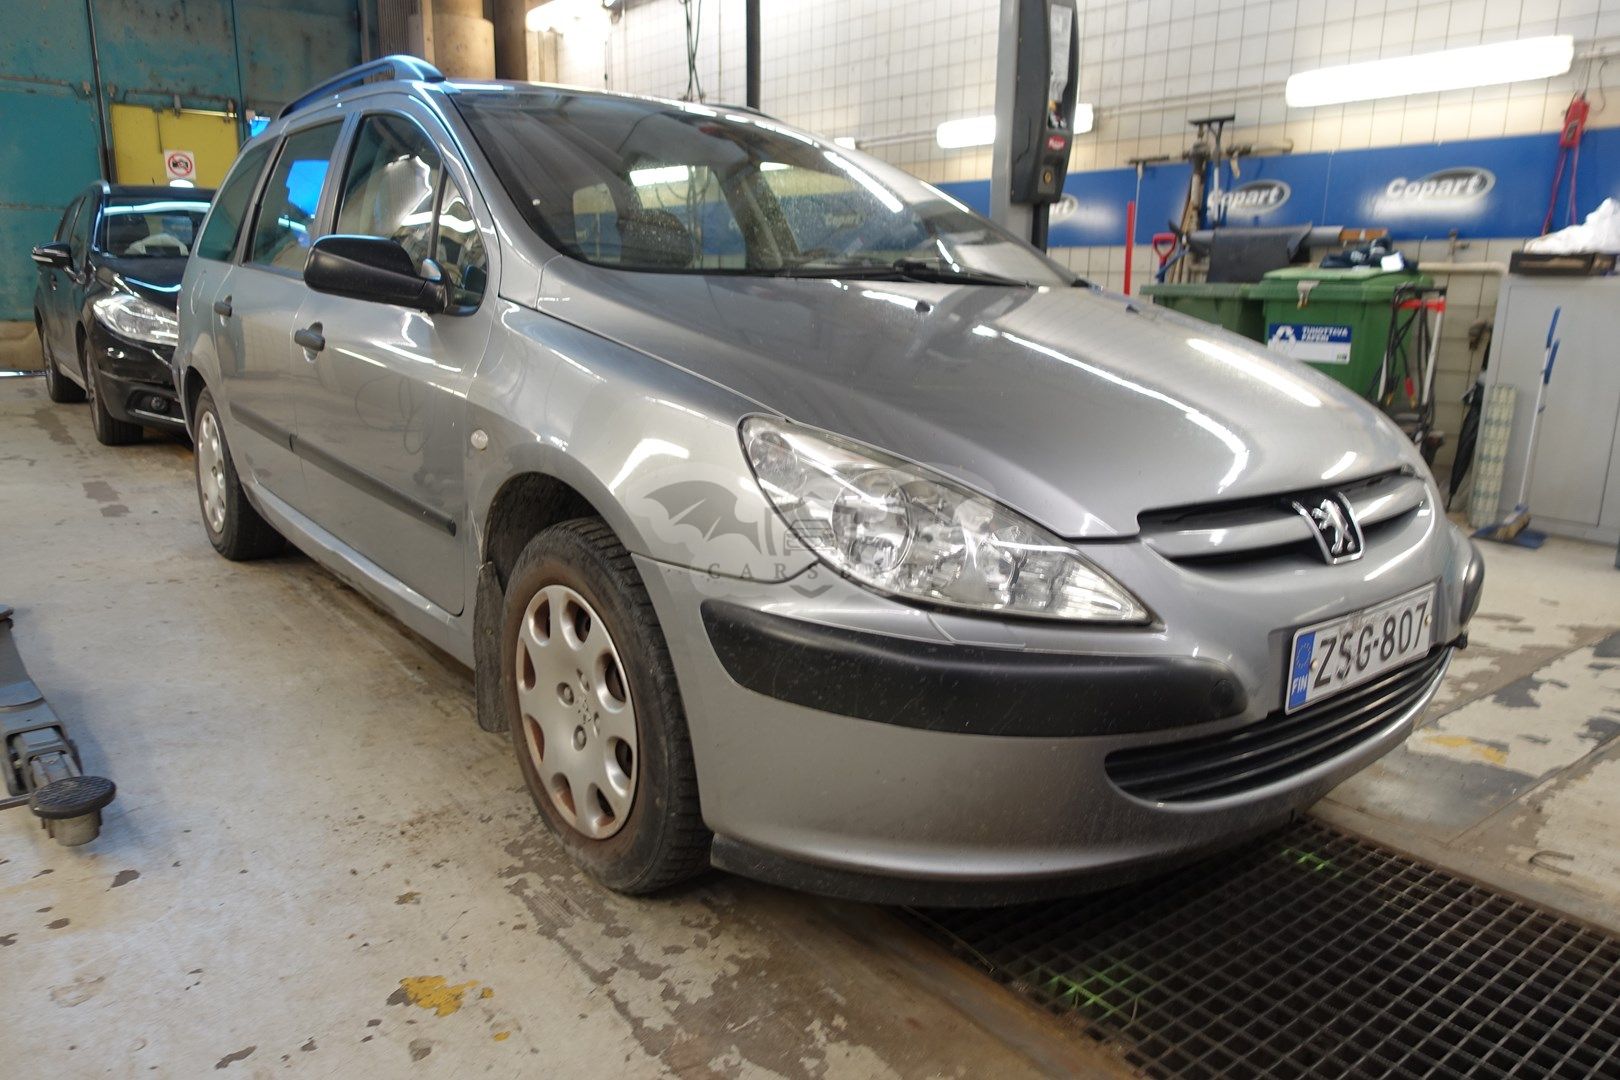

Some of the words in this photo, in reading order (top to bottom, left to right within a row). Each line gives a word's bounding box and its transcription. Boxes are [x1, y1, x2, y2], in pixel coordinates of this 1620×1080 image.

[1386, 174, 1480, 201] Copart
[1313, 601, 1428, 689] ZSG-807
[1291, 674, 1308, 696] FIN
